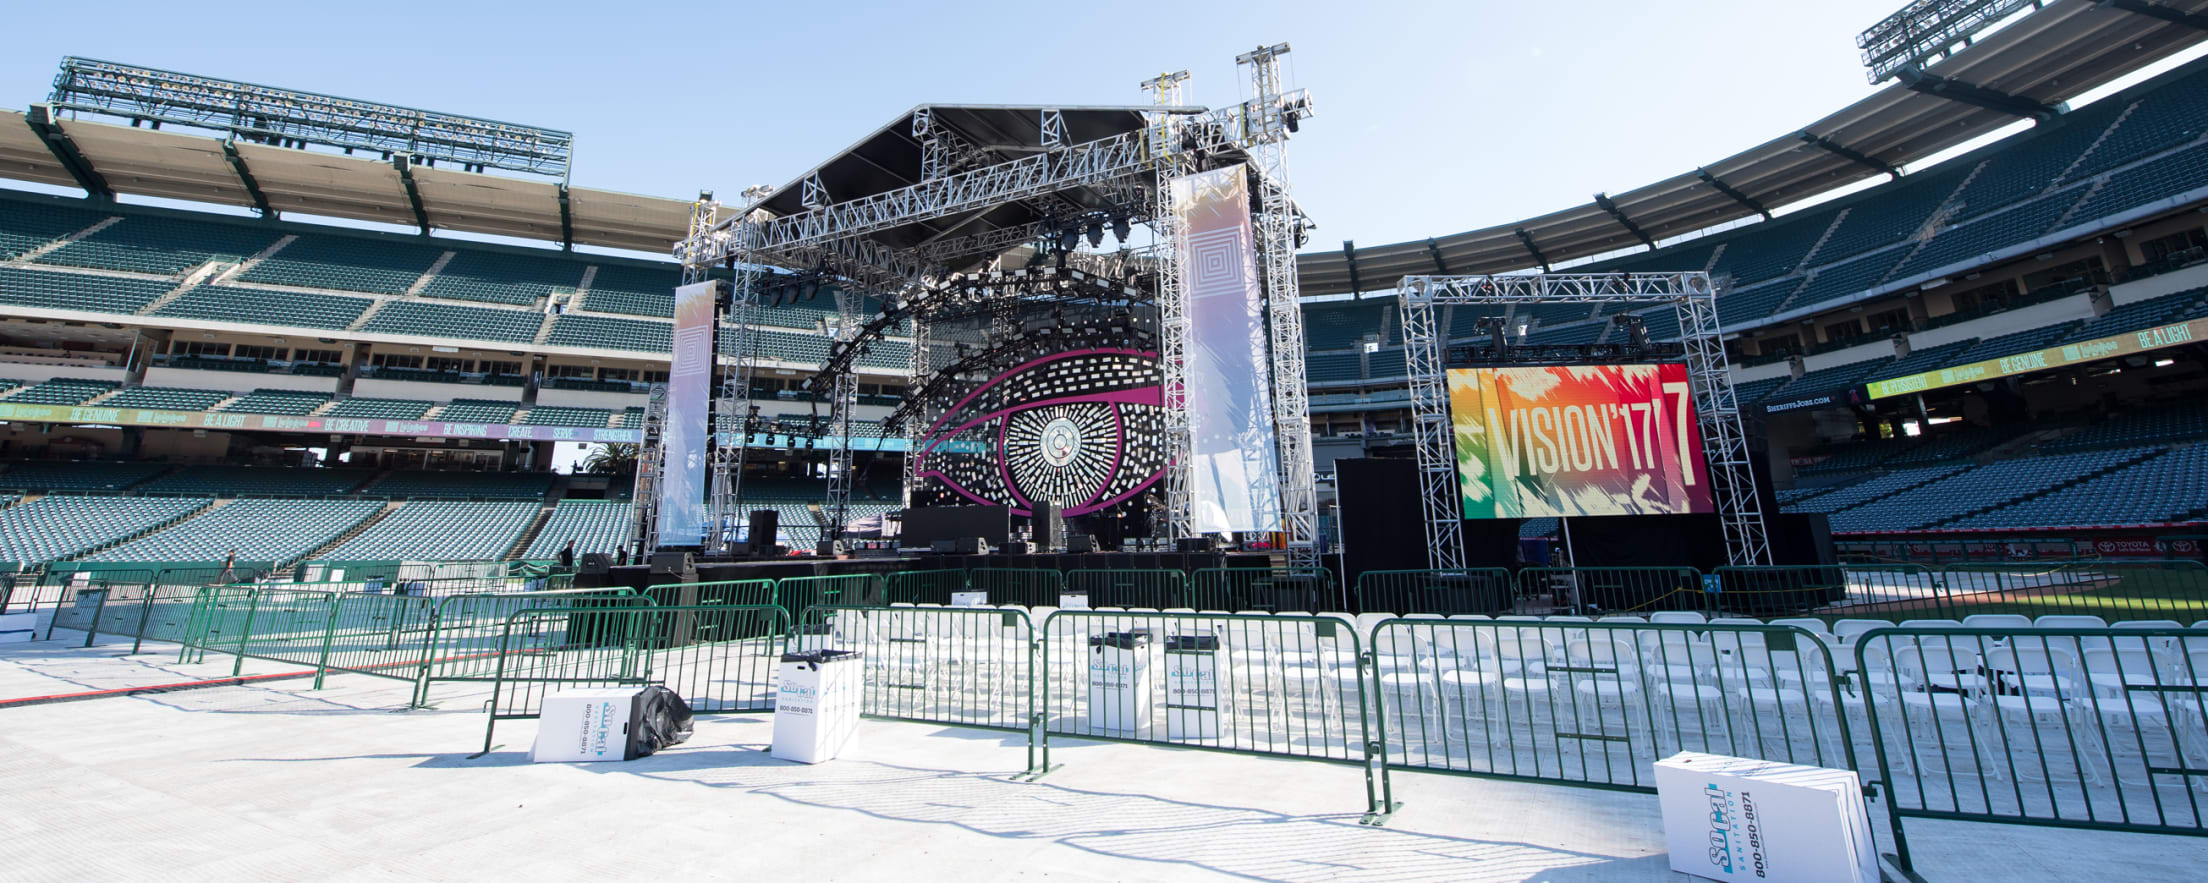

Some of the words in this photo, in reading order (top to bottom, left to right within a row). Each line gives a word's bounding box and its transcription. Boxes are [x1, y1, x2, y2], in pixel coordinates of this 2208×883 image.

[2137, 331, 2153, 348] BE
[2153, 328, 2163, 346] A
[2162, 323, 2192, 344] LIGHT
[2000, 359, 2012, 374] BE
[204, 413, 216, 426] BE
[215, 415, 222, 427] A
[222, 415, 246, 427] LIGHT
[325, 419, 335, 431] BE
[335, 420, 369, 432] CREATIVE
[443, 424, 454, 435] BE
[1741, 791, 1766, 879] 800-850-8871
